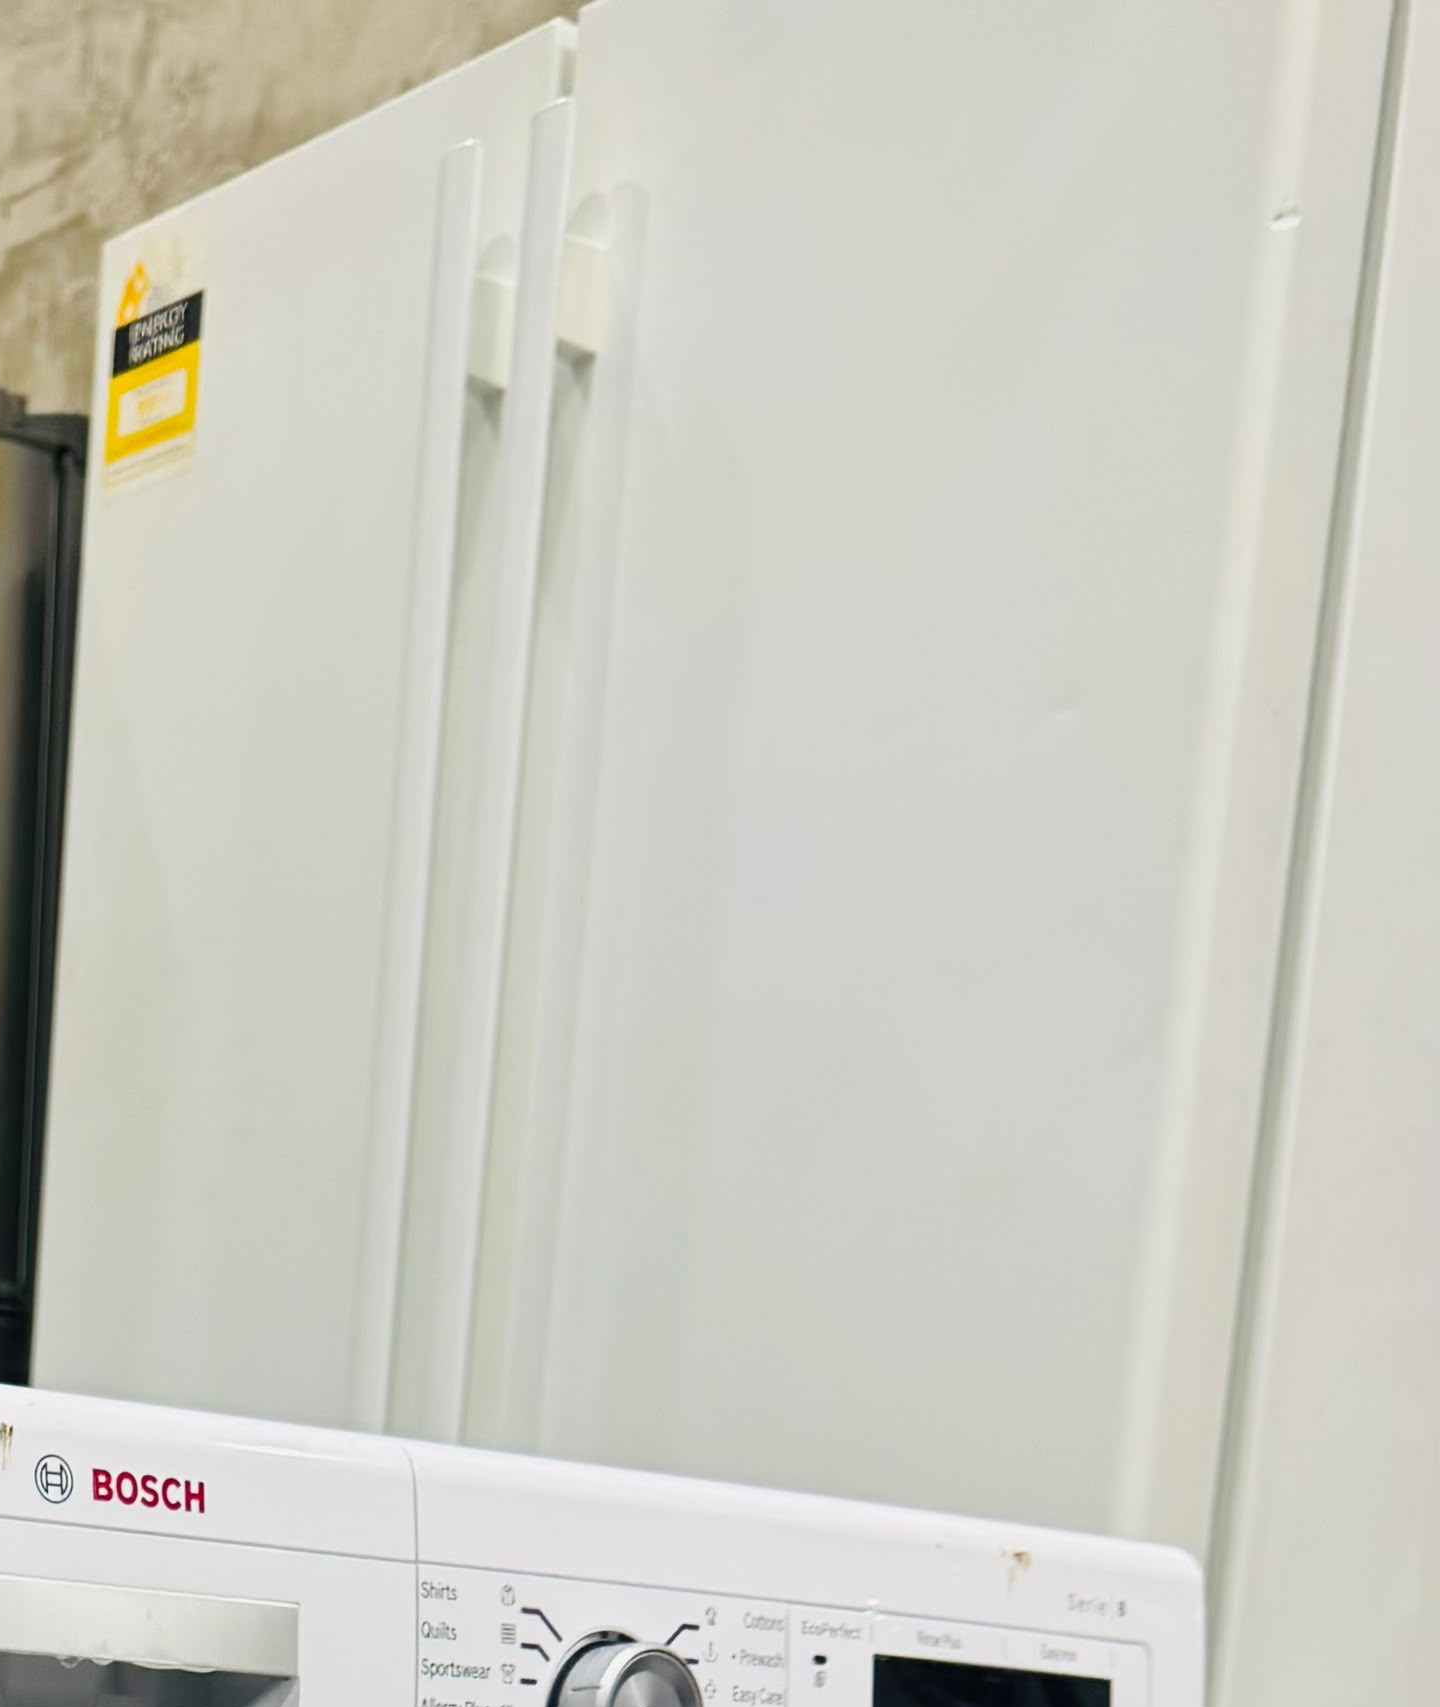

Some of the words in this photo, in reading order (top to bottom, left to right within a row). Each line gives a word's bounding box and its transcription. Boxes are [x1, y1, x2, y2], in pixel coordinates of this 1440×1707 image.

[131, 301, 188, 342] ENERGY
[128, 329, 185, 364] RATING
[92, 1468, 206, 1513] BOSCH
[421, 1581, 457, 1600] Shirts
[421, 1620, 457, 1641] Quilts
[421, 1658, 491, 1679] Sportswear
[733, 1685, 756, 1706] Easy
